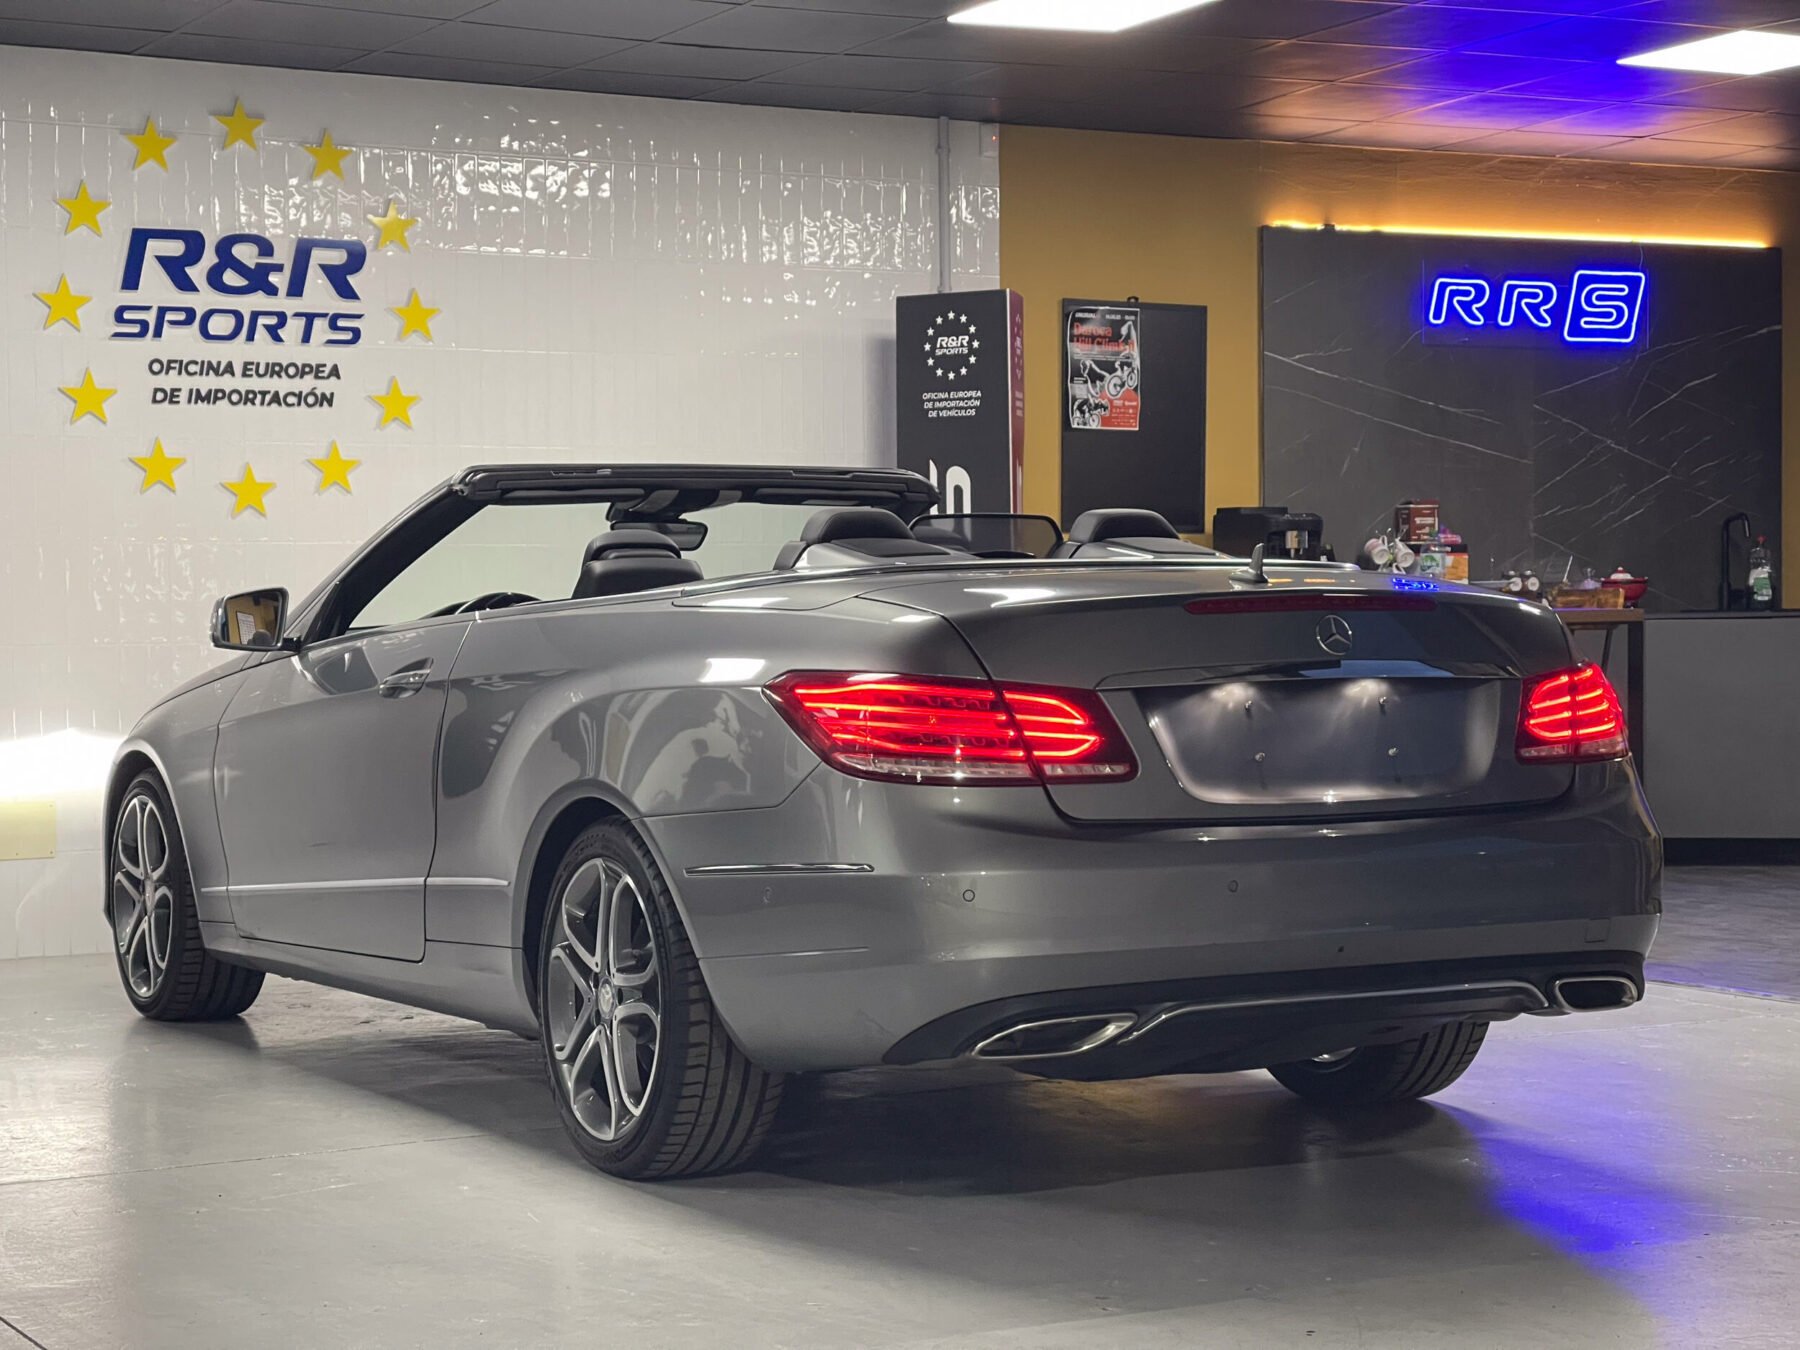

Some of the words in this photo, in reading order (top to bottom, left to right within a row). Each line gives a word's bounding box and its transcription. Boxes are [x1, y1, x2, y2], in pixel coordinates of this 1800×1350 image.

[120, 227, 367, 301] R&R
[110, 305, 365, 345] SPORTS
[936, 335, 970, 347] R&R
[935, 347, 969, 356] SPORTS
[147, 358, 236, 378] OFICINA
[241, 362, 341, 380] EUROPEA
[151, 387, 182, 405] DE
[187, 387, 335, 408] IMPORTACIÓN
[922, 392, 949, 400] OFICINA
[950, 390, 982, 399] EUROPEA
[924, 401, 933, 409] DE
[934, 399, 981, 408] IMPORTACIÓN
[928, 410, 938, 418] DE
[939, 408, 976, 417] VEHÍCULOS
